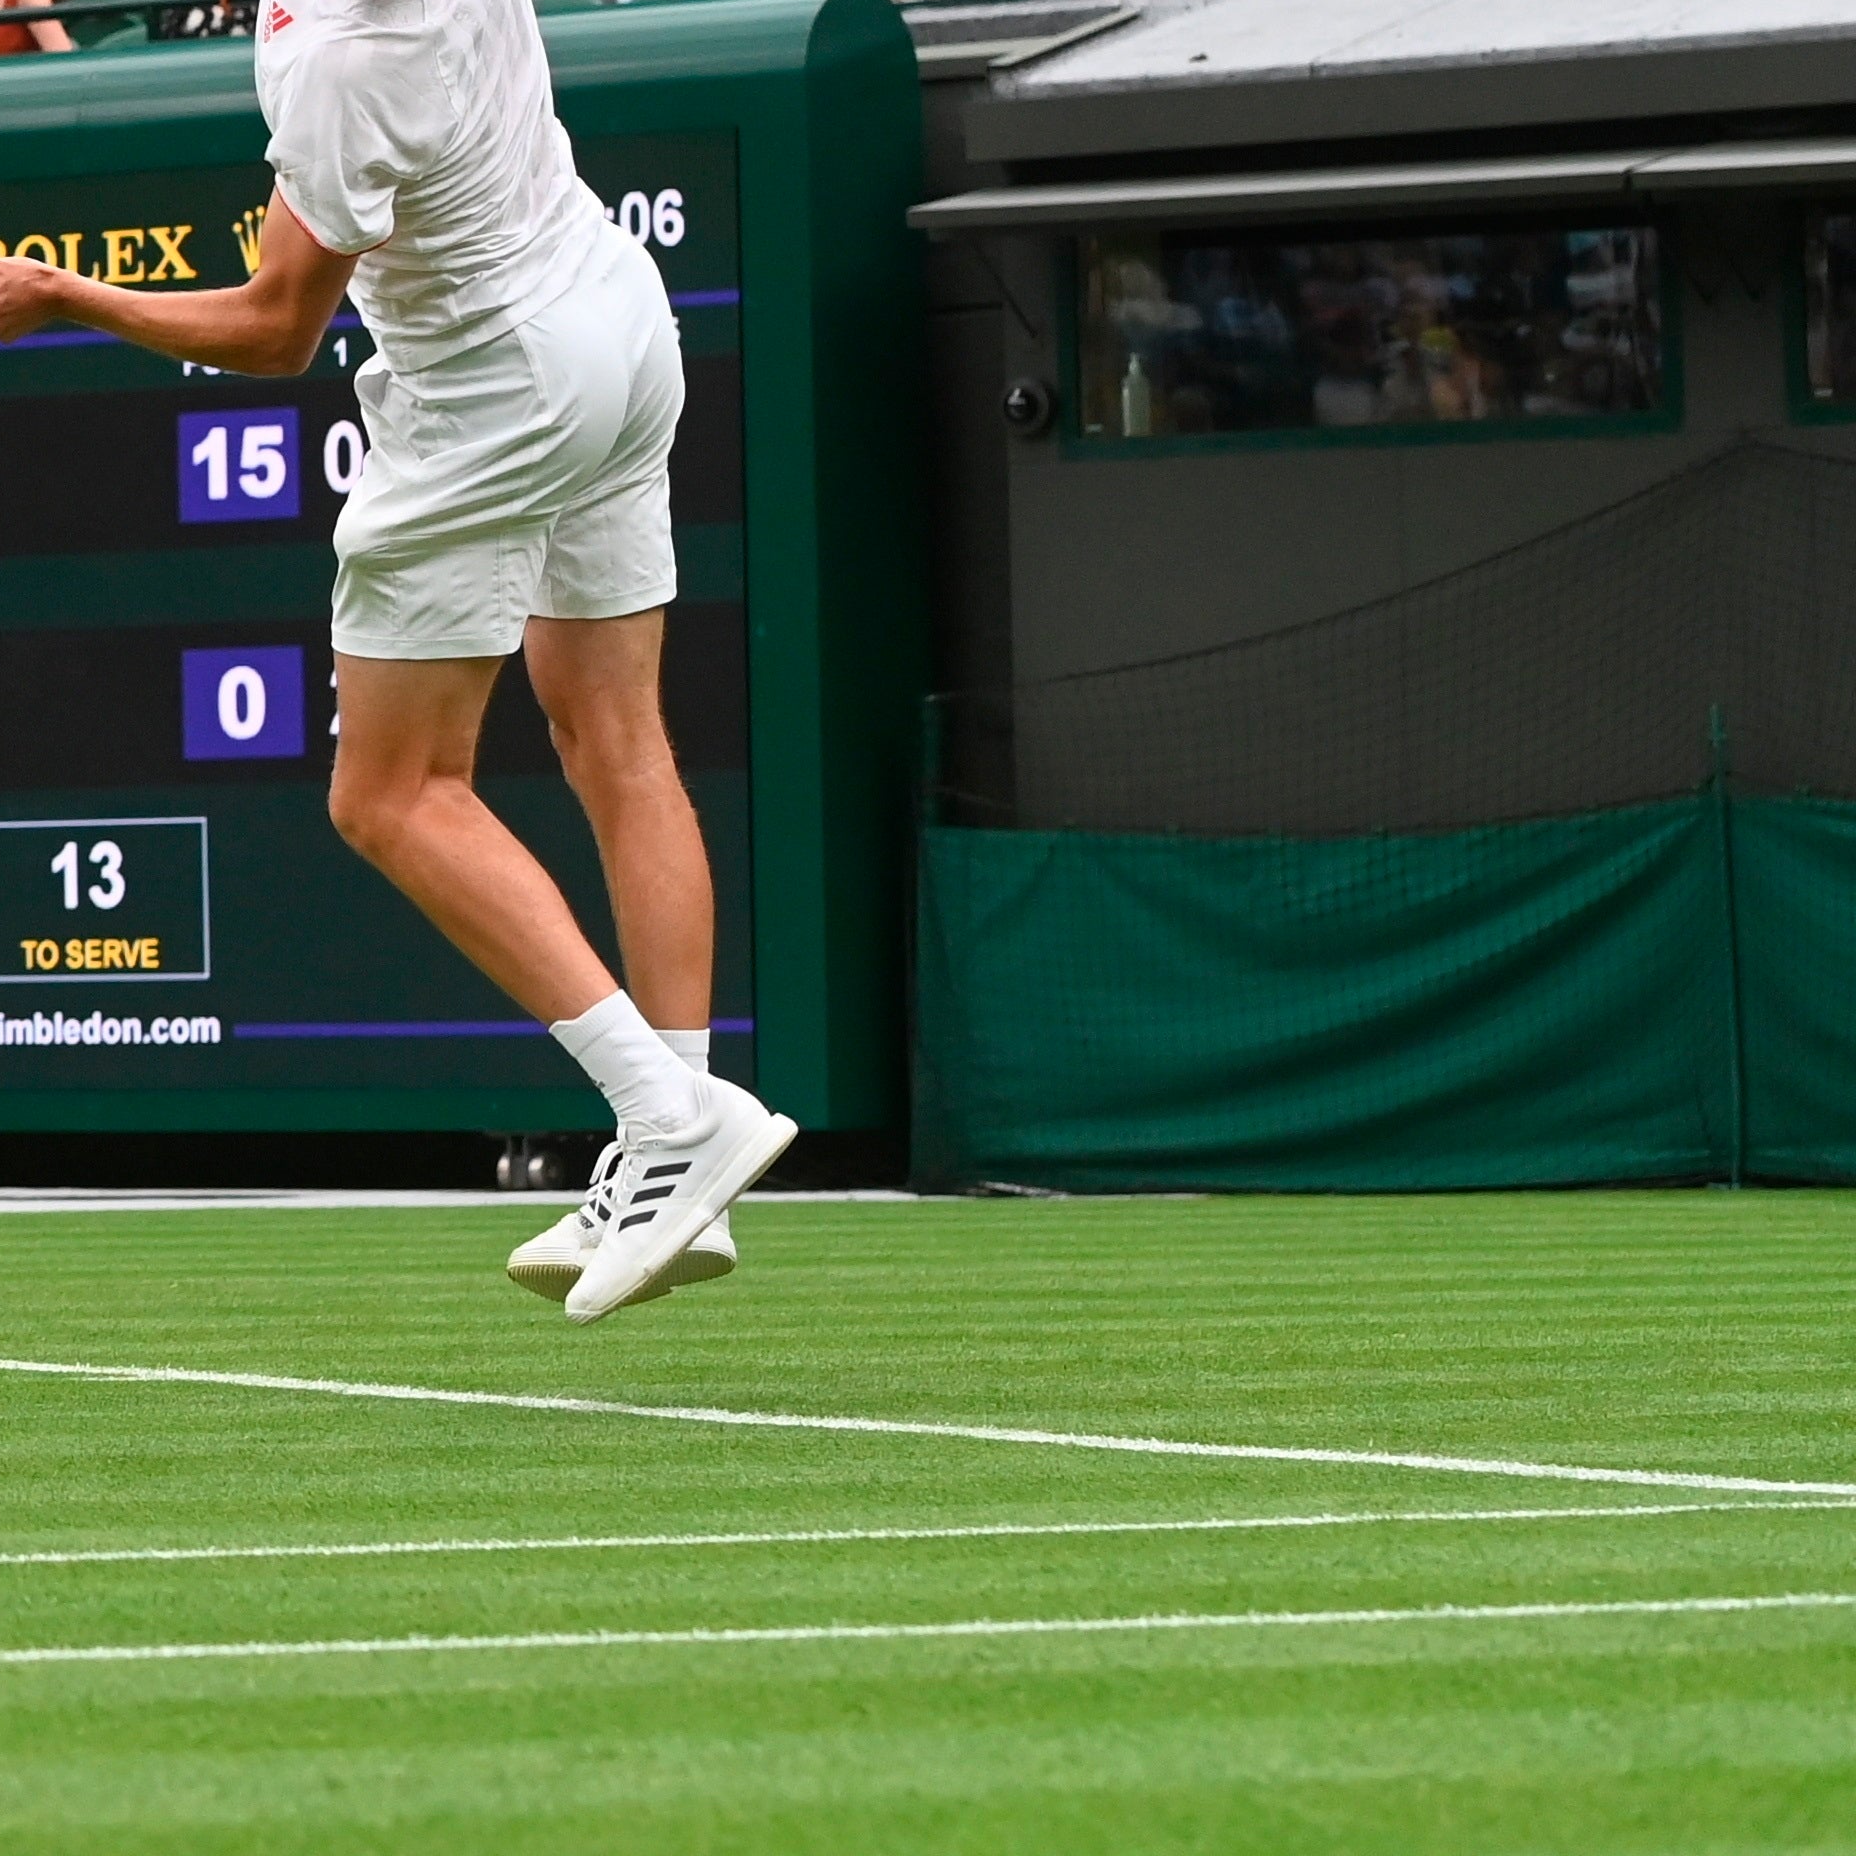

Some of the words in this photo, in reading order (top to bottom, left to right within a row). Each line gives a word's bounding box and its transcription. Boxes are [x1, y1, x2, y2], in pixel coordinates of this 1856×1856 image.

[192, 425, 287, 500] 15
[218, 665, 266, 740] 0
[51, 840, 126, 910] 13
[20, 940, 60, 970] TO
[64, 938, 160, 970] SERVE
